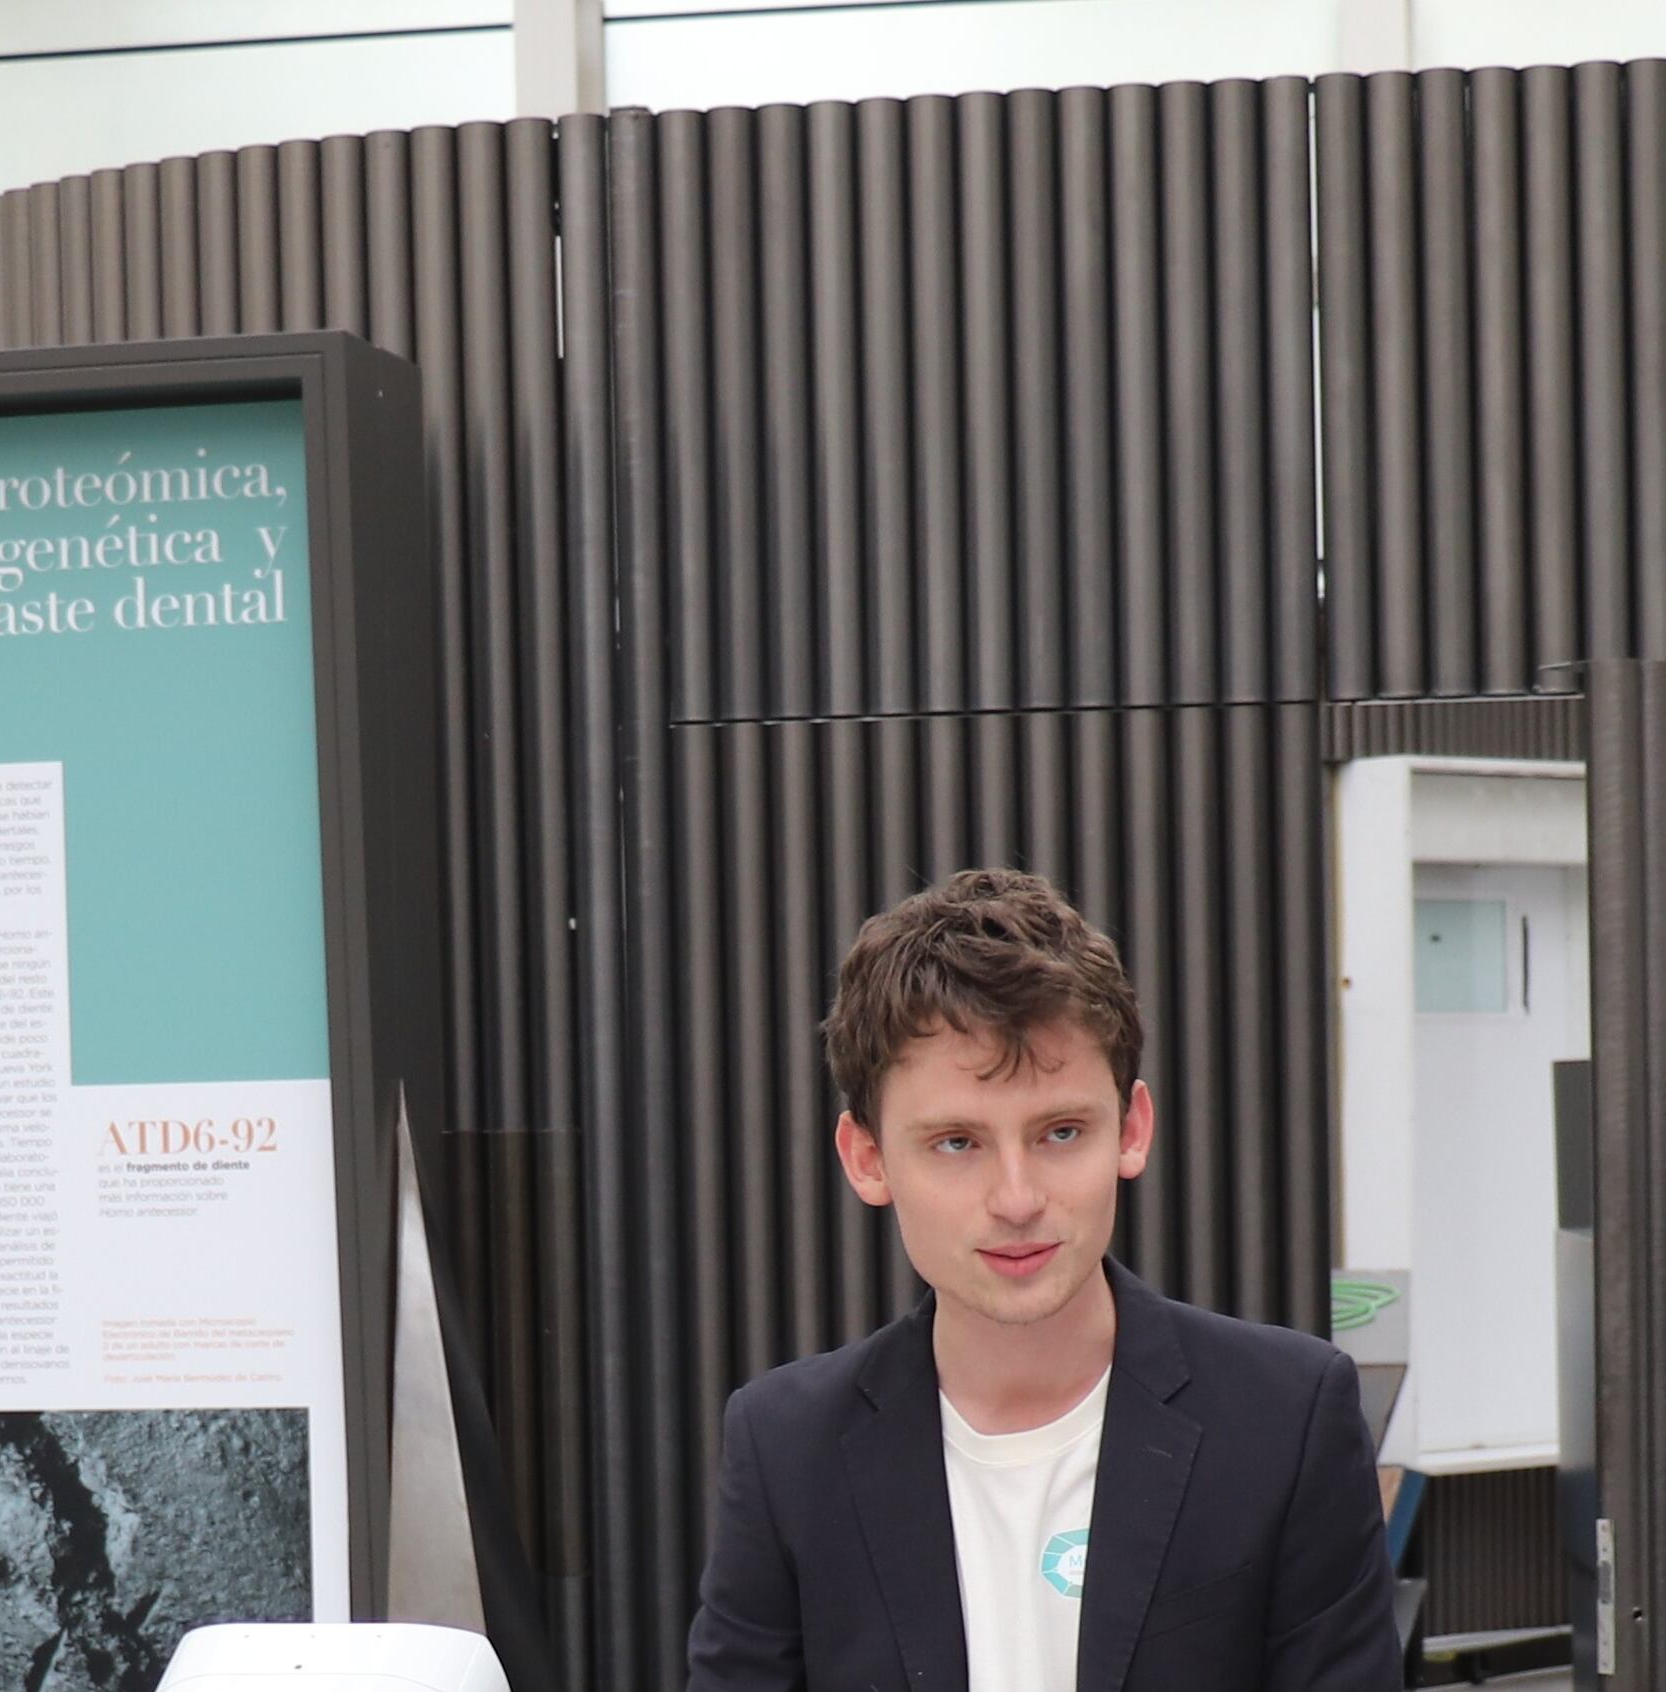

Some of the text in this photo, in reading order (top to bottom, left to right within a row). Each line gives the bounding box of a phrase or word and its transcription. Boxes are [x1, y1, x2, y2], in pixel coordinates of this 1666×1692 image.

[254, 525, 287, 579] y
[112, 568, 287, 630] dental
[98, 1117, 278, 1156] ATD6-92
[126, 1161, 189, 1173] fragmento
[192, 1160, 208, 1170] de
[211, 1159, 250, 1170] diente
